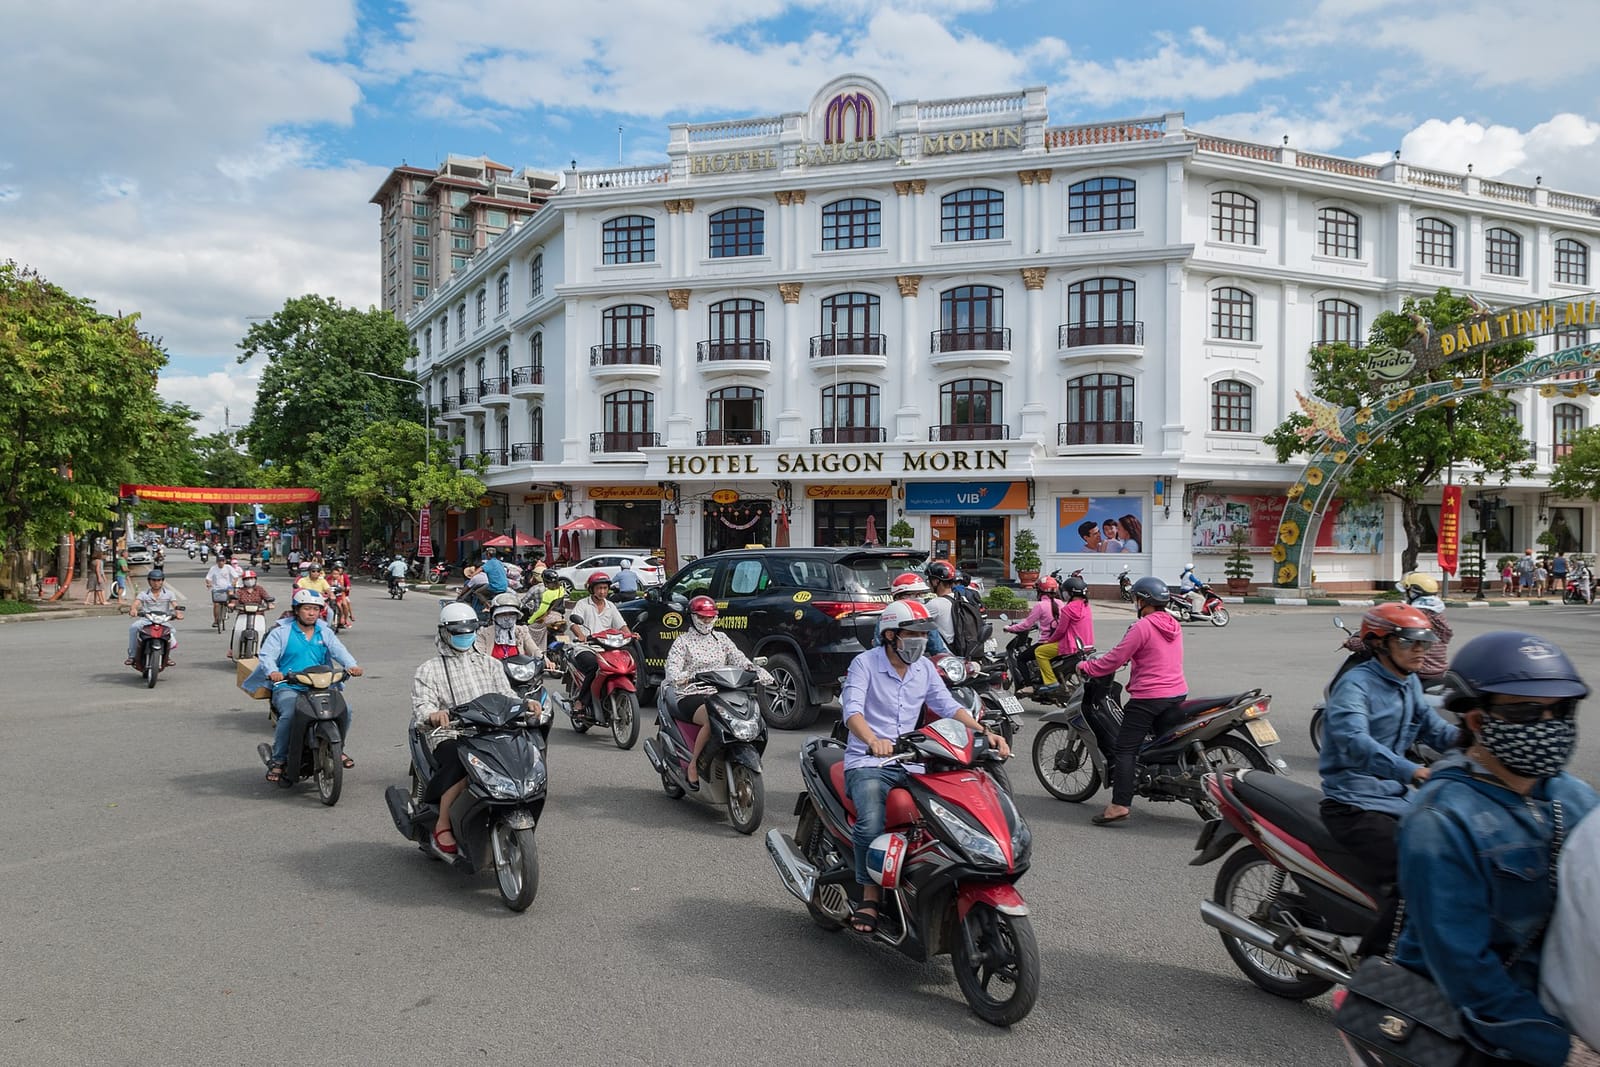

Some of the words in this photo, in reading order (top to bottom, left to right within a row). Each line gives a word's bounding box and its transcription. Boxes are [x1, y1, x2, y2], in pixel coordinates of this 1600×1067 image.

[689, 149, 778, 175] HOTEL
[796, 137, 902, 167] SAIGON
[922, 126, 1023, 156] MORIN
[1440, 322, 1492, 357] ĐẬM
[1496, 304, 1556, 338] TÌNH
[667, 454, 759, 475] HOTEL
[777, 452, 884, 474] SAIGON
[903, 449, 1009, 472] MORIN
[957, 493, 980, 504] VIB
[660, 631, 672, 640] TAXI
